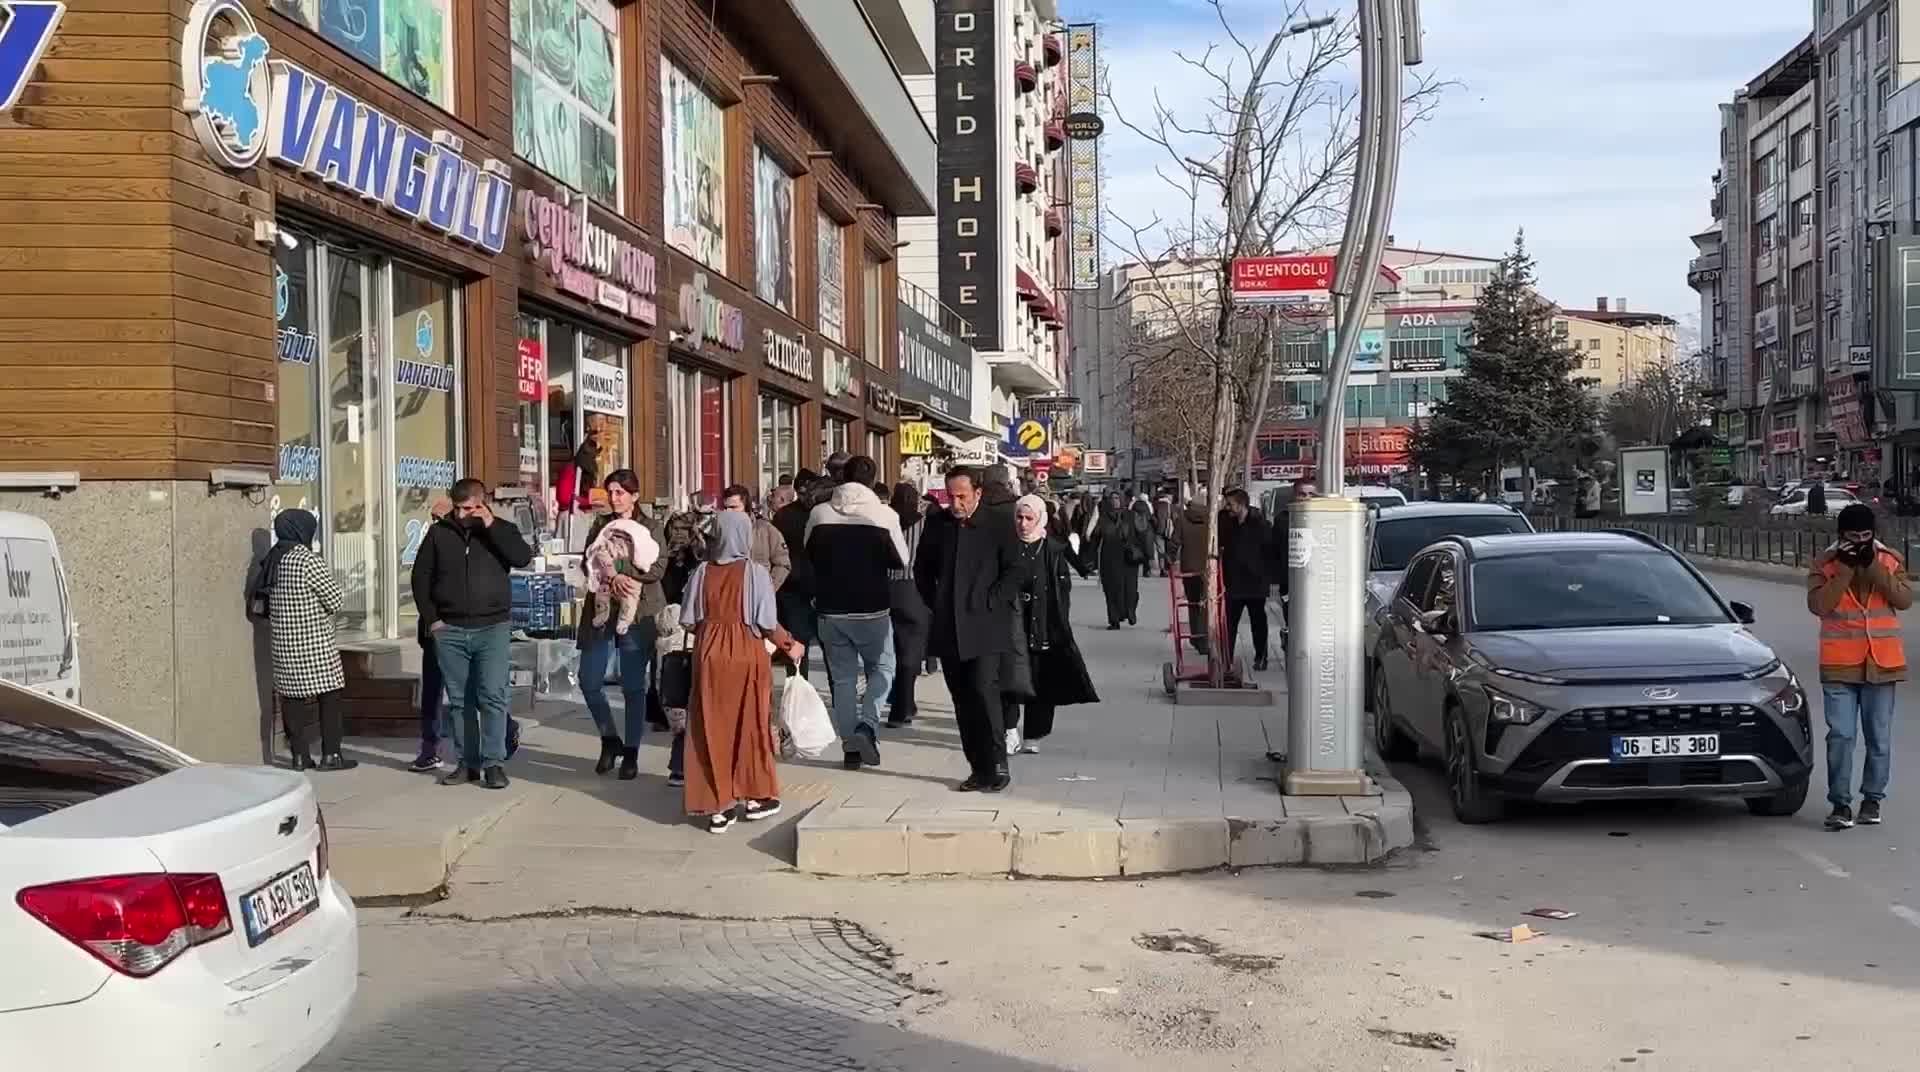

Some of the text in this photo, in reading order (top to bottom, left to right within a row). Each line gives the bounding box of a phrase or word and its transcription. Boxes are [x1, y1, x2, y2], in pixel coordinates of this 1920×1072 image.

[1068, 122, 1100, 130] WORLD
[268, 60, 512, 253] VANGÖLÜ
[952, 176, 982, 338] HOTEL
[1239, 280, 1268, 288] SOKAK
[1400, 313, 1437, 327] ADA
[397, 358, 455, 392] VANGÖLÜ
[912, 434, 931, 452] WC
[1622, 740, 1640, 755] 06
[1688, 737, 1717, 753] 380
